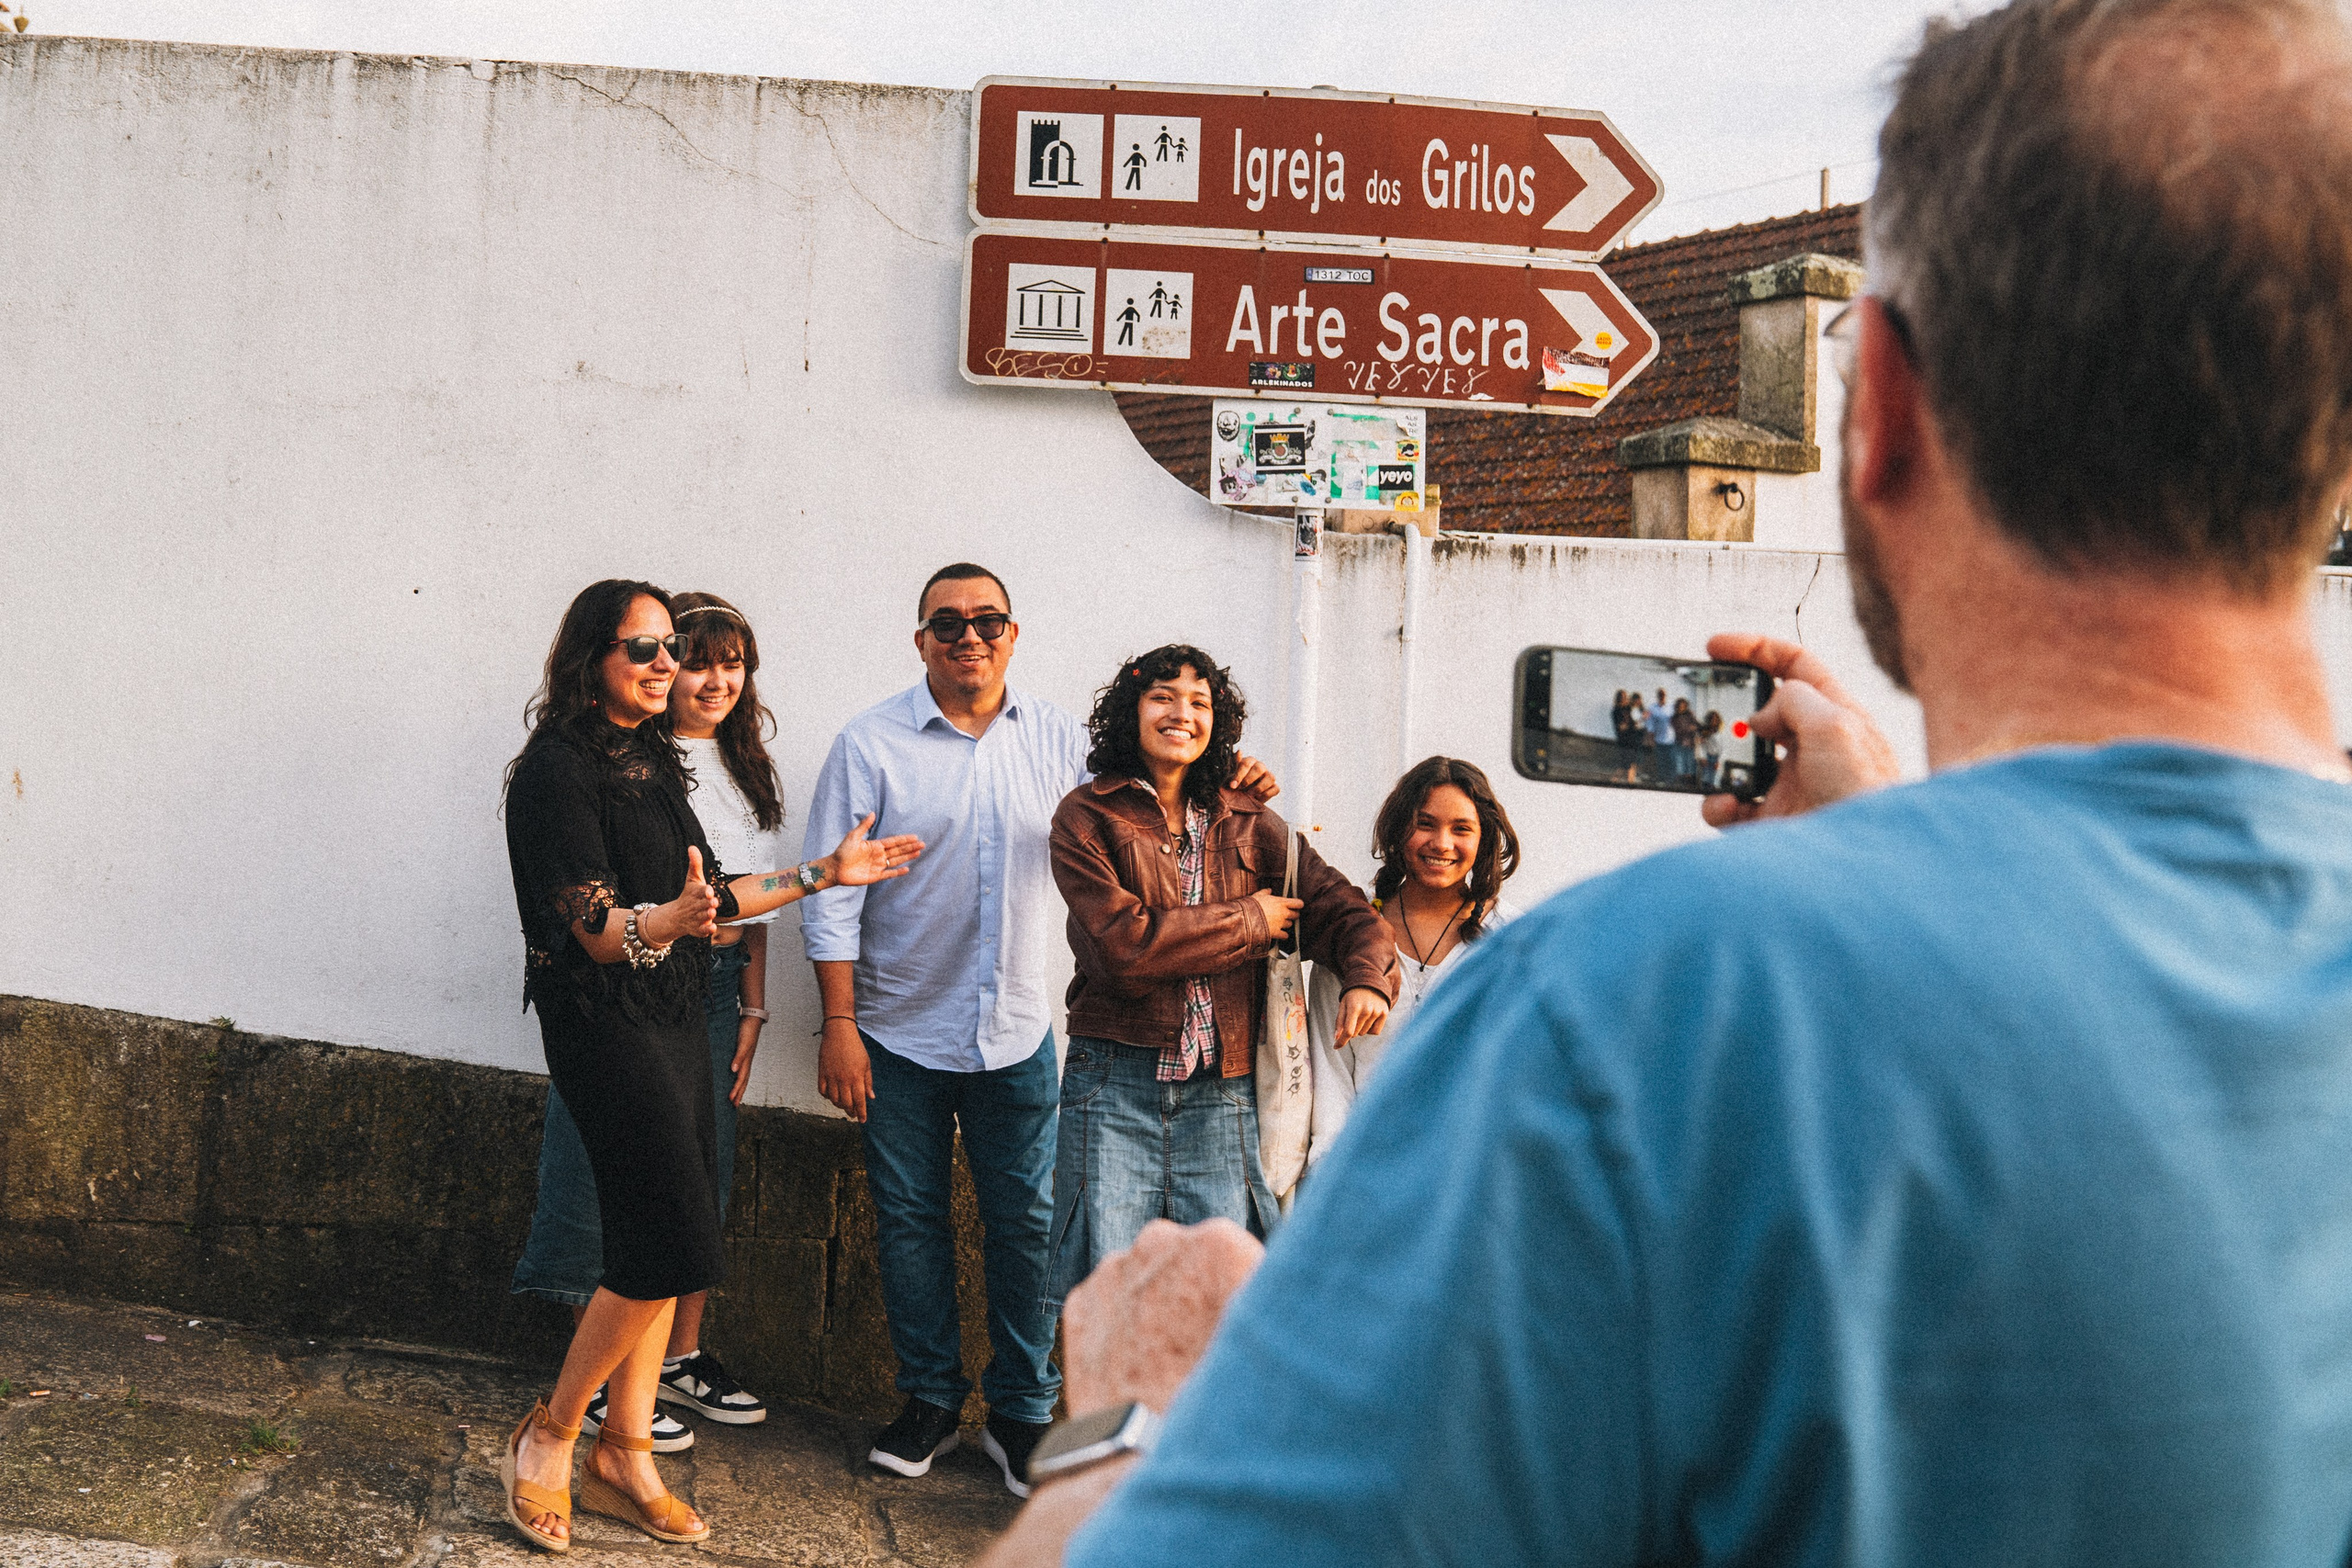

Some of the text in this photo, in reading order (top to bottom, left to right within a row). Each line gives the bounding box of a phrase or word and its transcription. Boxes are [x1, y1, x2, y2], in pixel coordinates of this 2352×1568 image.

[1233, 128, 1535, 215] Igreja dos Grilos
[1315, 270, 1369, 281] 1312 TOC
[1226, 285, 1532, 371] Arte Sacra
[1251, 378, 1313, 388] ARLEKINADOS
[1379, 470, 1413, 485] yeyo
